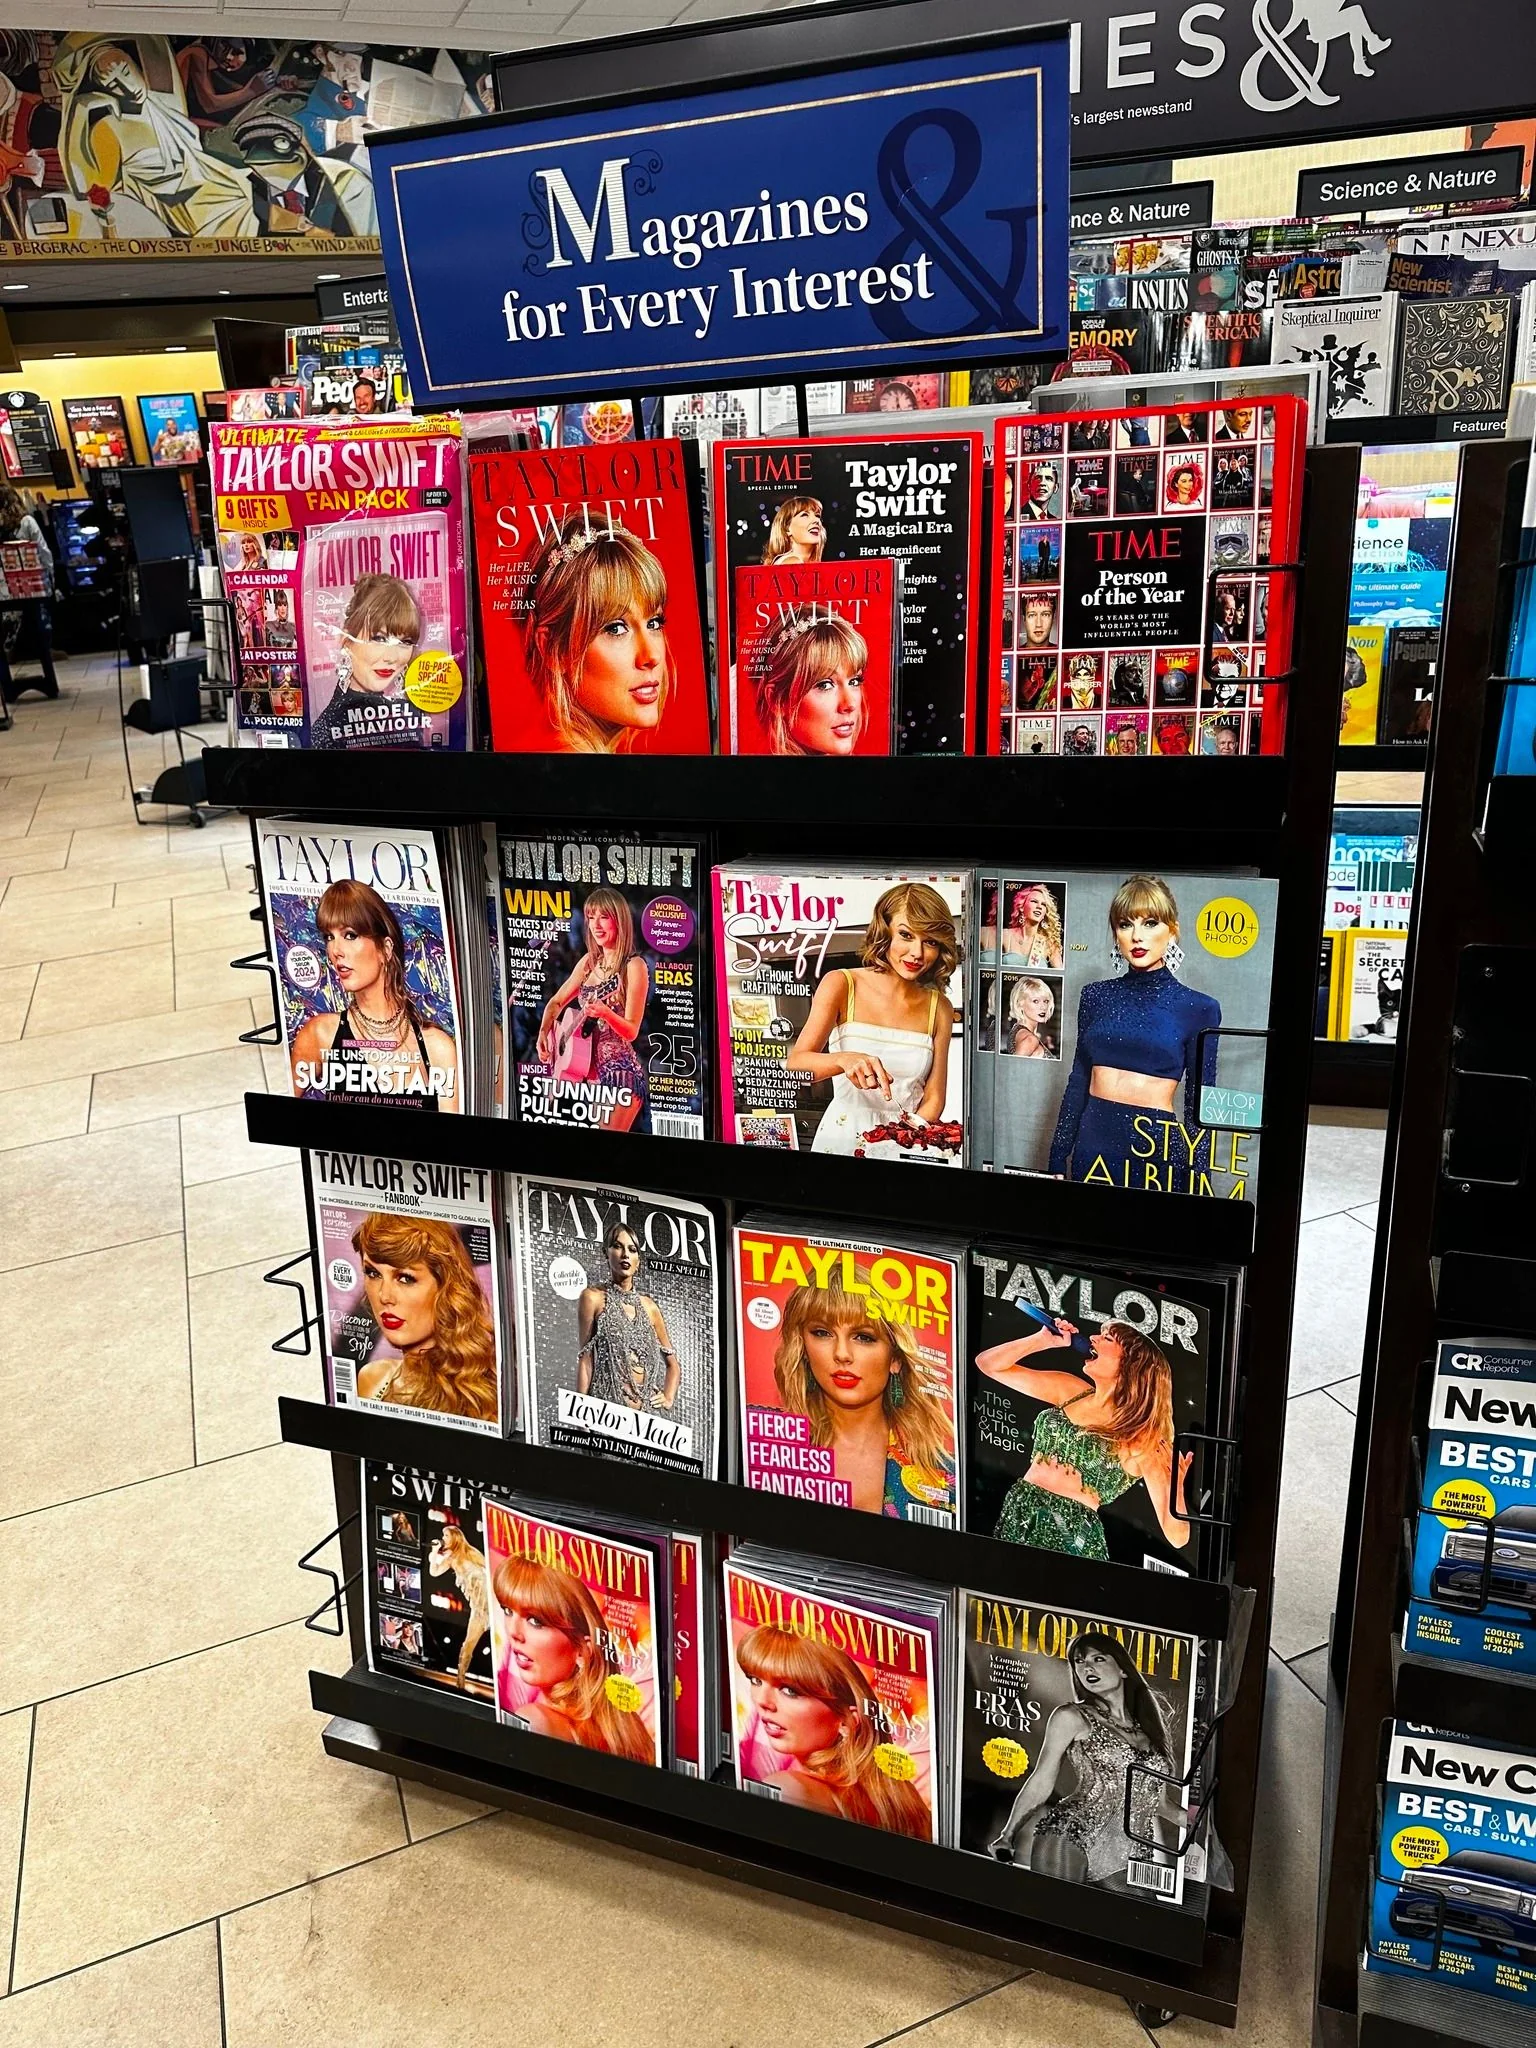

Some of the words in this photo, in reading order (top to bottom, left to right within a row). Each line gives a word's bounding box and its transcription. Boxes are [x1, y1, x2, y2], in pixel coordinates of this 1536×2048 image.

[1083, 106, 1124, 125] largest
[1127, 99, 1192, 121] newsstand
[1320, 179, 1399, 201] Science
[1404, 174, 1422, 193] &
[1427, 168, 1496, 191] Nature
[535, 158, 869, 269] Magazines
[14, 241, 90, 255] BERGERAC
[100, 242, 126, 252] THE
[129, 239, 191, 254] ODYSSEY
[214, 239, 261, 253] JUNGLE
[1392, 259, 1423, 276] New
[1132, 278, 1189, 310] ISSUES
[1389, 275, 1452, 294] Scientist
[502, 291, 568, 342] for
[578, 283, 719, 339] Every
[730, 253, 935, 320] Interest
[1281, 309, 1333, 327] Skeptical
[1334, 308, 1382, 324] Inquirer
[1453, 419, 1507, 433] Featured
[219, 445, 337, 491] TAYLOR
[342, 440, 450, 488] SWIFT
[472, 447, 682, 502] TAYLOR
[732, 454, 813, 482] TIME
[845, 458, 957, 491] Taylor
[226, 502, 232, 518] 9
[237, 499, 278, 519] GIFTS
[307, 493, 351, 510] FAN
[356, 489, 410, 509] PACK
[855, 487, 946, 518] Swift
[496, 497, 664, 548] SWIFT
[849, 524, 860, 537] A
[862, 523, 926, 538] Magical
[929, 522, 953, 534] Era
[860, 547, 878, 556] Her
[880, 545, 941, 556] Magnificent
[1088, 527, 1182, 562] TIME
[489, 564, 506, 573] Her
[507, 561, 532, 573] LIFE,
[233, 573, 288, 586] CALENDAR
[487, 576, 502, 585] Her
[504, 575, 537, 585] MUSIC
[744, 568, 884, 599] TAYLOR
[1099, 570, 1168, 587] Person
[1368, 582, 1398, 591] Ultimate
[1401, 582, 1421, 591] Guide
[502, 589, 509, 597] &
[511, 587, 524, 597] All
[1081, 590, 1102, 607] of
[1106, 589, 1139, 606] the
[1142, 587, 1185, 604] Year
[493, 601, 509, 610] Her
[510, 600, 536, 610] ERAS
[755, 599, 868, 629] SWIFT
[1100, 622, 1139, 630] WORLD'S
[1107, 613, 1136, 621] YEARS
[1156, 612, 1169, 620] THE
[1084, 630, 1142, 639] INFLUENTIAL
[1145, 628, 1179, 636] PEOPLE
[347, 702, 413, 722] MODEL
[331, 716, 433, 740] BEHAVIOUR
[264, 834, 437, 893] TAYLOR
[500, 840, 600, 883] TAYLOR
[607, 844, 696, 888] SWIFT
[504, 888, 572, 919] WIN!
[728, 880, 844, 932] Taylor
[508, 918, 539, 930] TICKETS
[541, 920, 553, 931] TO
[556, 921, 570, 932] SEE
[1204, 911, 1257, 933] 100+
[508, 928, 539, 940] TAYLOR
[540, 930, 558, 942] LIVE
[724, 911, 867, 978] Swift
[1205, 933, 1248, 946] PHOTOS
[655, 962, 666, 971] ALL
[668, 962, 693, 972] ABOUT
[756, 969, 794, 983] AT-HOME
[655, 970, 693, 987] ERAS
[741, 980, 782, 996] CRAFTING
[784, 983, 811, 997] GUIDE
[733, 1029, 745, 1042] 16
[746, 1030, 763, 1044] DIY
[320, 1049, 340, 1061] THE
[342, 1049, 421, 1064] UNSTOPPABLE
[648, 1033, 697, 1077] 25
[734, 1042, 786, 1058] PROJECTS!
[744, 1058, 779, 1068] BAKING!
[295, 1061, 456, 1099] SUPERSTAR!
[744, 1068, 814, 1081] SCRAPBOOKING!
[746, 1077, 800, 1089] BEDAZZLING!
[519, 1075, 529, 1093] 5
[532, 1078, 632, 1107] STUNNING
[746, 1088, 796, 1099] FRIENDSHIP
[520, 1094, 614, 1124] PULL-OUT
[747, 1097, 797, 1109] BRACELETS!
[1131, 1115, 1252, 1177] STYLE
[315, 1151, 404, 1193] TAYLOR
[413, 1162, 488, 1203] SWIFT
[384, 1192, 420, 1207] FANBOOK
[529, 1188, 710, 1267] TAYLOR
[823, 1240, 851, 1250] ULTIMATE
[853, 1243, 872, 1252] GUIDE
[742, 1240, 948, 1313] TAYLOR
[973, 1255, 1199, 1354] TAYLOR
[866, 1297, 949, 1336] SWIFT
[1451, 1352, 1482, 1371] CR
[1482, 1363, 1520, 1374] Reports
[1484, 1354, 1533, 1367] Consumer
[983, 1390, 1011, 1409] The
[566, 1393, 627, 1432] Taylor
[630, 1414, 688, 1452] Made
[973, 1401, 1017, 1424] Music
[750, 1412, 806, 1442] FIERCE
[981, 1430, 1025, 1453] Magic
[750, 1441, 830, 1474] FEARLESS
[1490, 1474, 1531, 1489] CARS
[1440, 1499, 1487, 1513] POWERFUL
[1444, 1490, 1460, 1500] THE
[1462, 1492, 1486, 1503] MOST
[732, 1576, 828, 1643] TAYLOR
[830, 1609, 924, 1674] SWIFT
[1485, 1627, 1521, 1640] COOLEST
[1483, 1643, 1491, 1652] of
[1492, 1645, 1513, 1655] 2024
[1484, 1634, 1502, 1645] NEW
[1503, 1638, 1524, 1650] CARS
[975, 1689, 1041, 1721] ERAS
[982, 1709, 1031, 1733] TOUR
[1401, 1745, 1499, 1788] New
[1397, 1791, 1492, 1824] BEST
[1489, 1813, 1501, 1830] &
